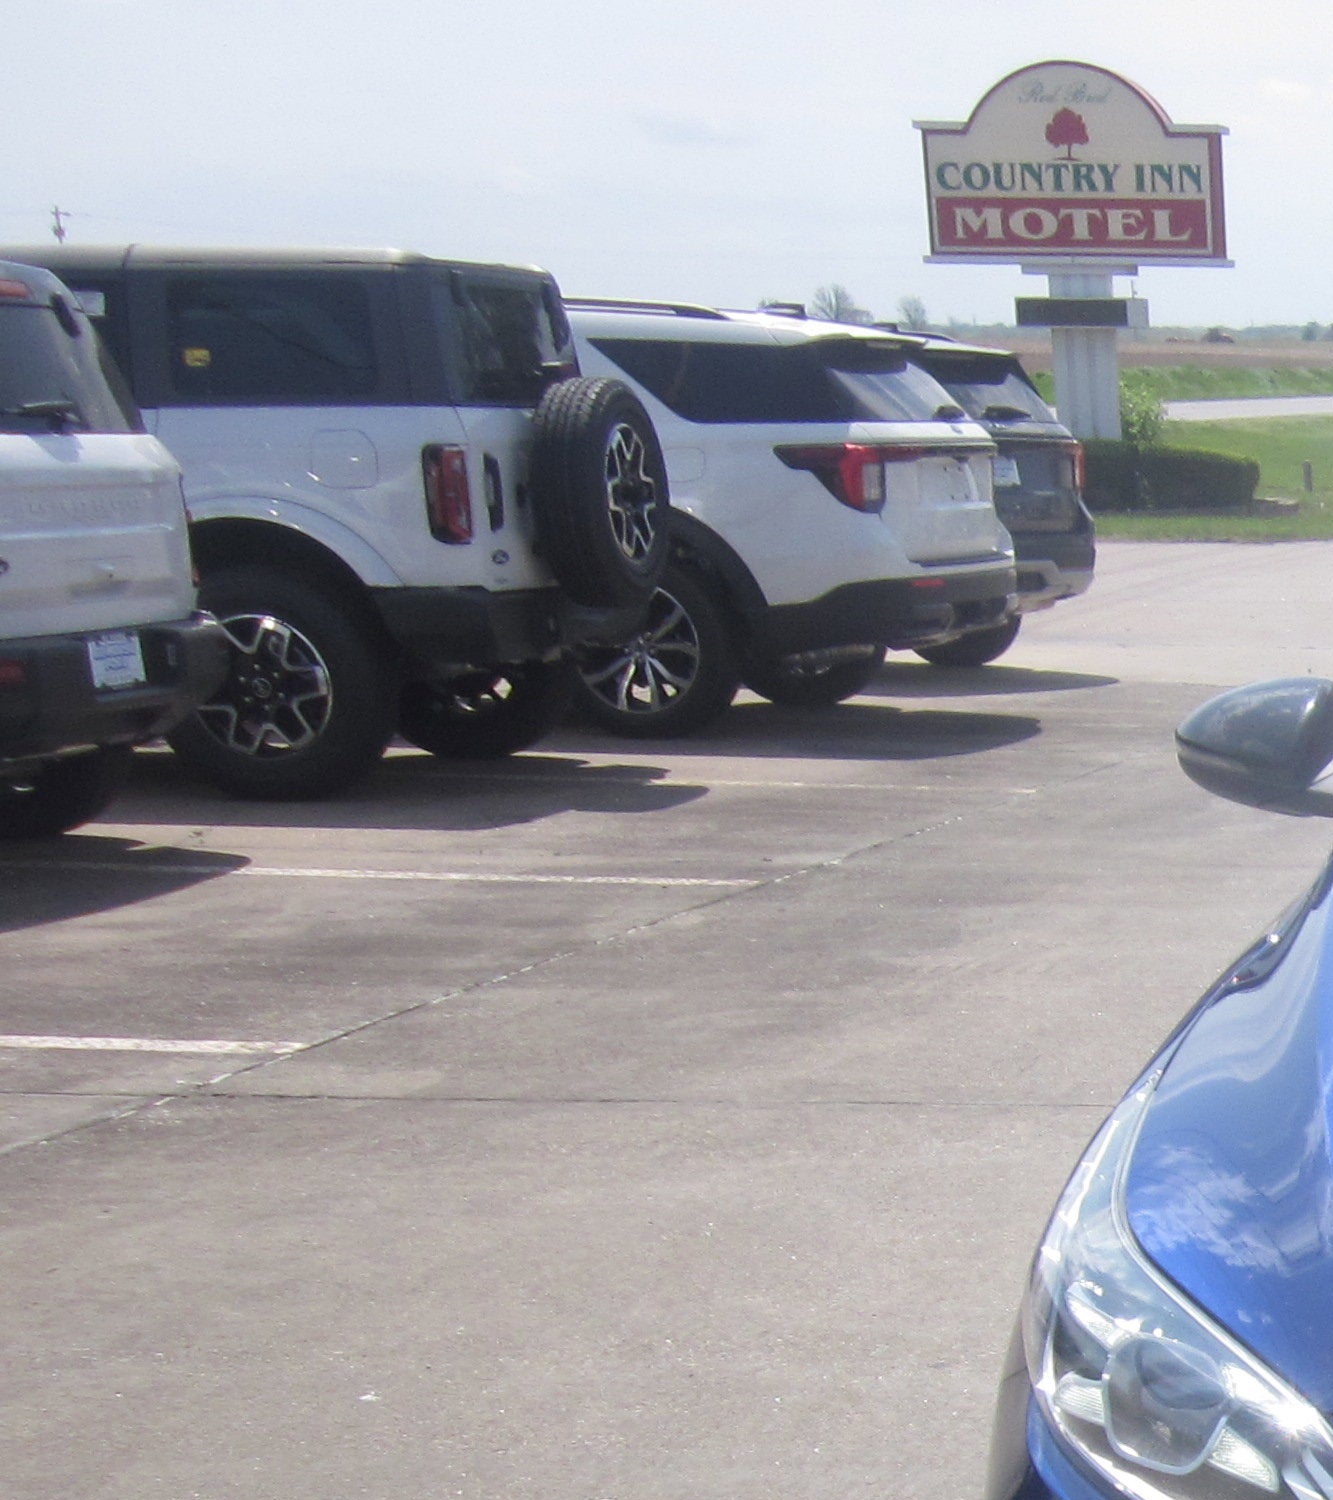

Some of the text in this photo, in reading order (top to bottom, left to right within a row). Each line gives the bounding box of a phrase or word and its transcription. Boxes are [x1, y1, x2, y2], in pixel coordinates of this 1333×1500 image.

[936, 162, 1204, 194] COUNTRY INN
[954, 207, 1192, 241] MOTEL
